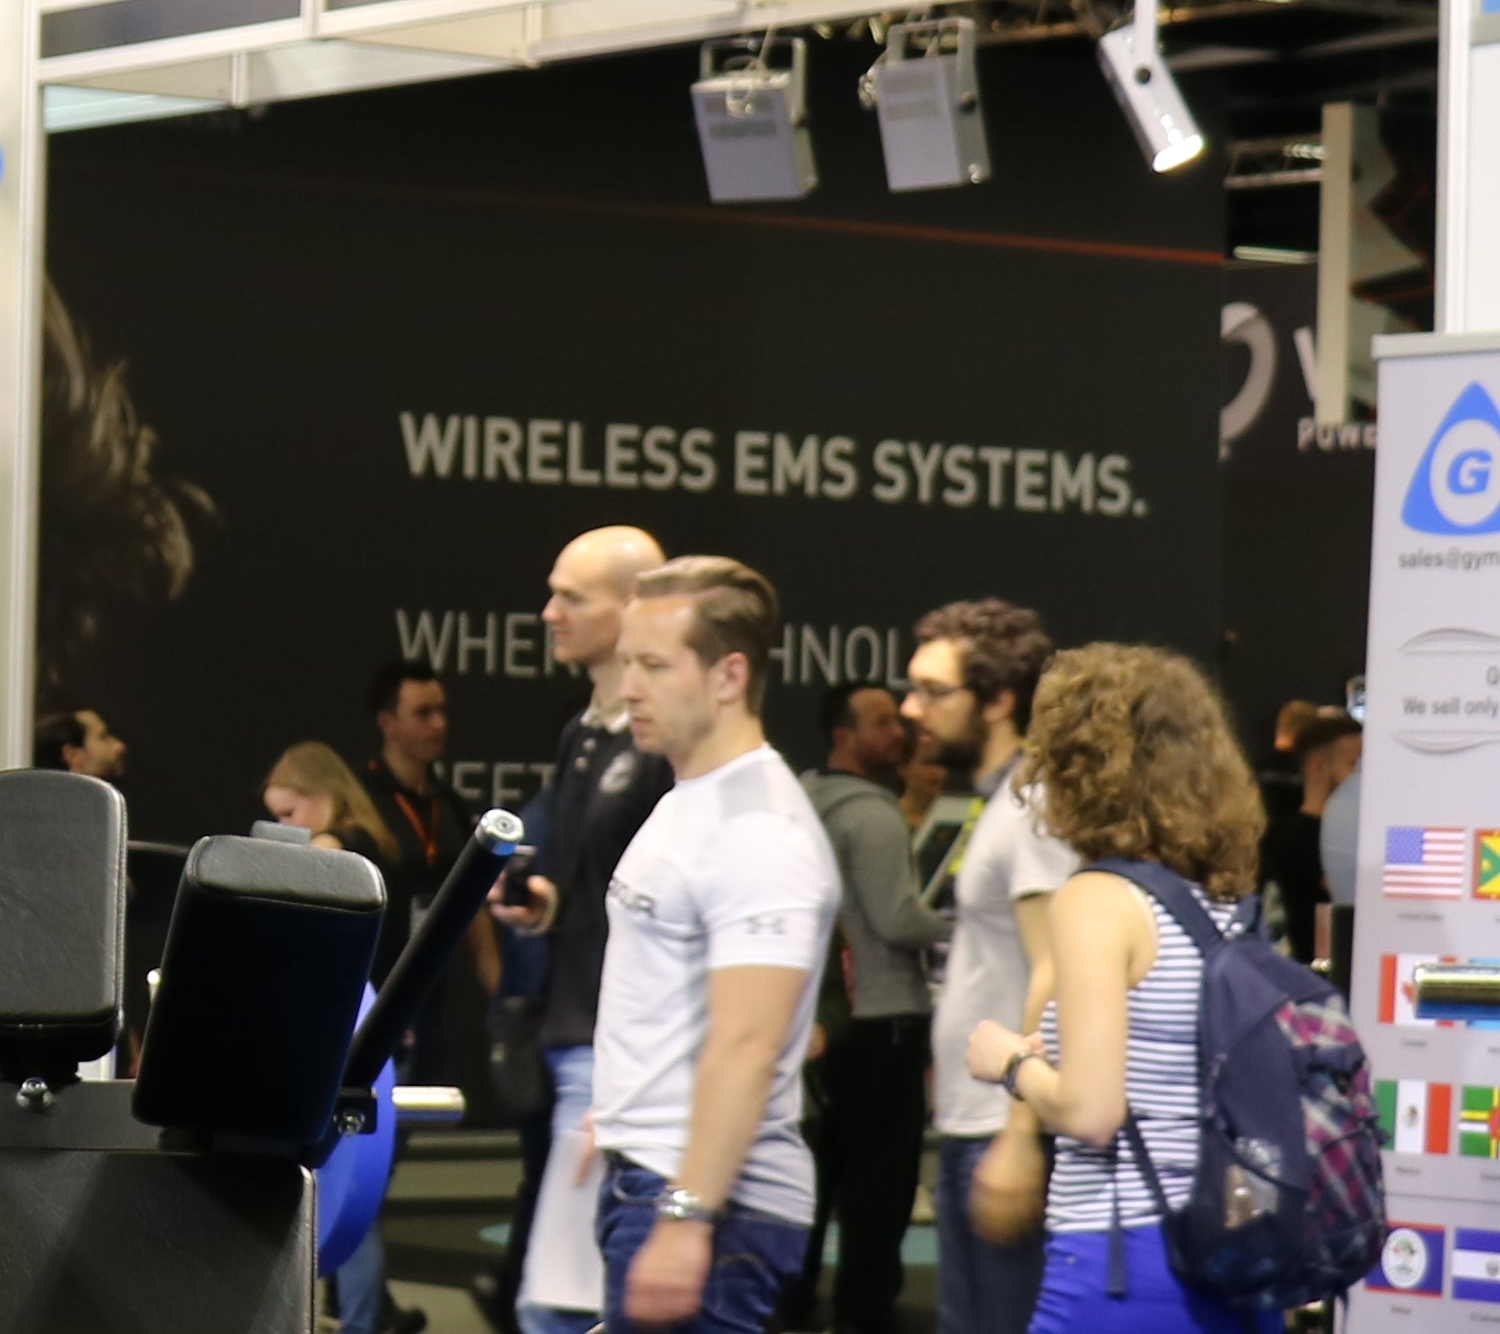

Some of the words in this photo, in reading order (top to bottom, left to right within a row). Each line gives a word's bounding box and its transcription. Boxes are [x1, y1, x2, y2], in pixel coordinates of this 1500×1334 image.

[400, 410, 718, 493] WIRELESS
[734, 430, 858, 500] EMS
[871, 439, 1148, 518] SYSTEMS.
[1446, 449, 1493, 496] G
[1402, 696, 1427, 716] We
[1432, 696, 1461, 716] sell
[1464, 697, 1499, 719] only
